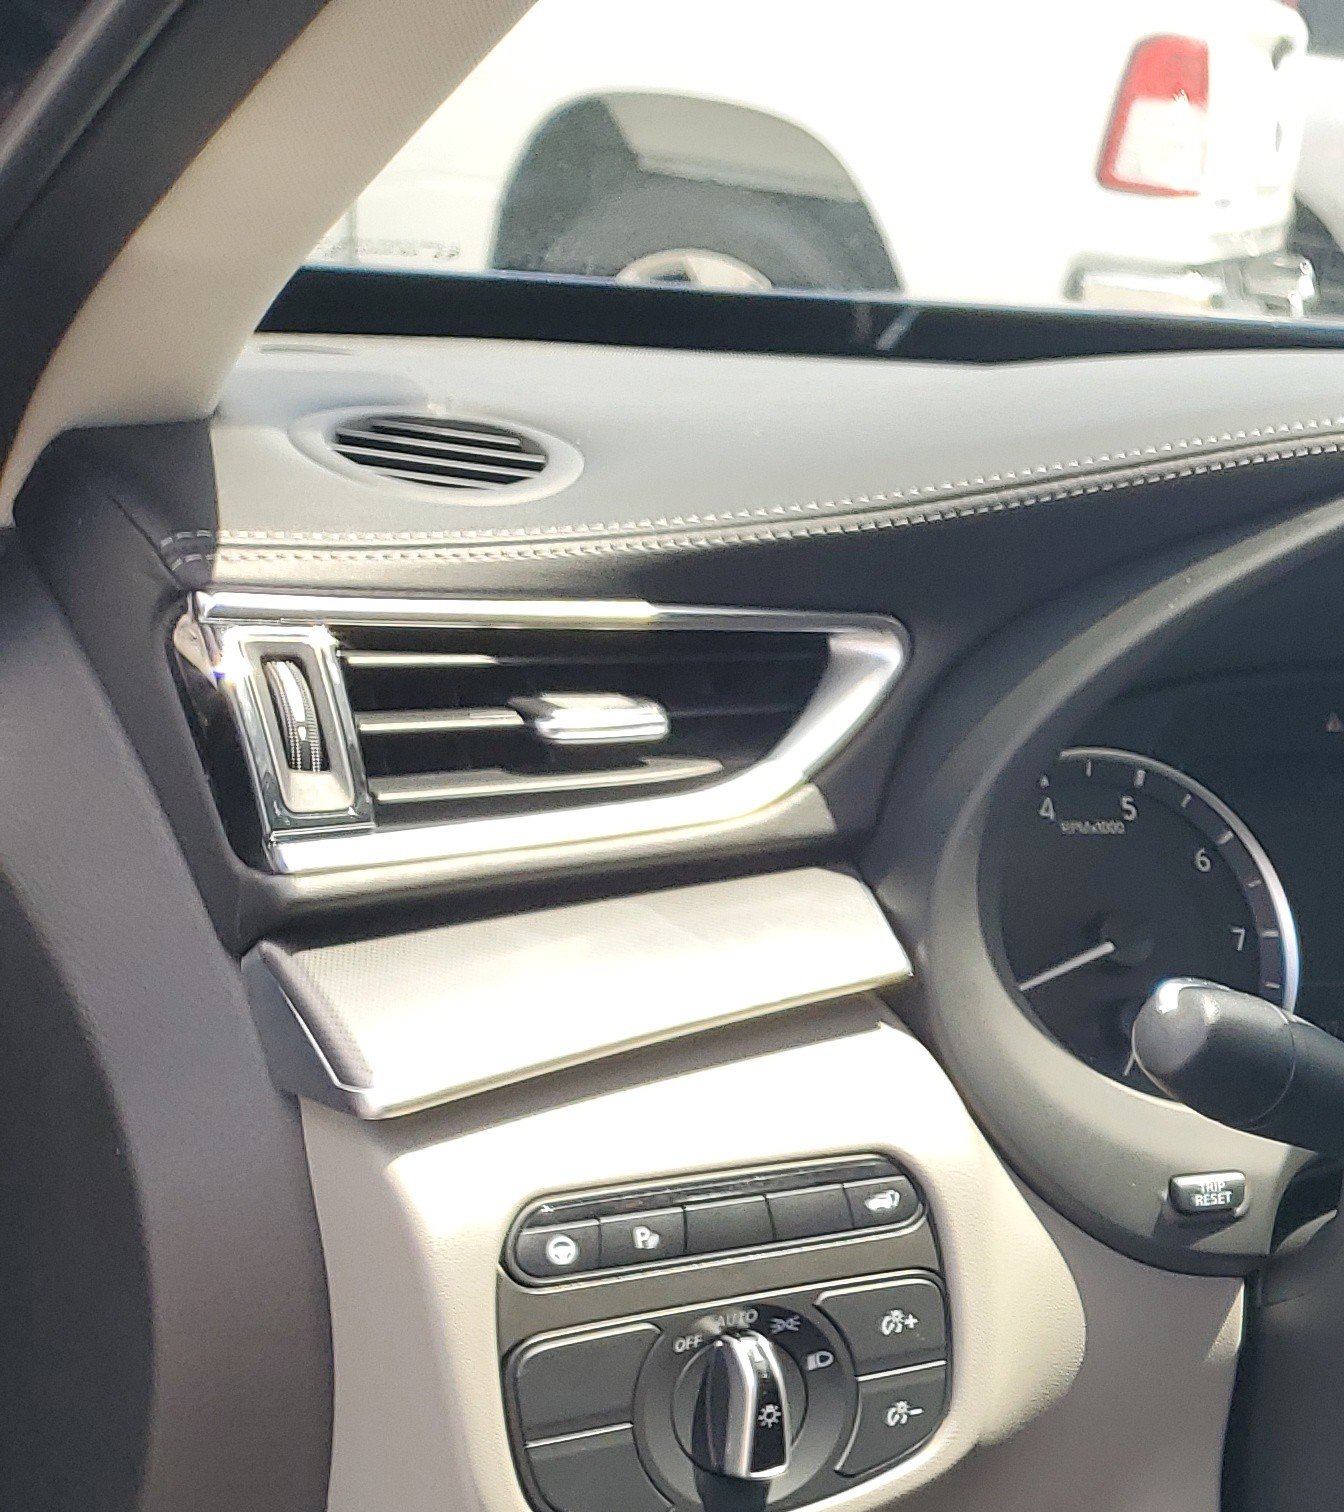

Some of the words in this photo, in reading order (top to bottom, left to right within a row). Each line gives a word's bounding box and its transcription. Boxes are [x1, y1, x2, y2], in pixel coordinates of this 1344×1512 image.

[1039, 797, 1055, 820] 4
[1121, 796, 1138, 821] 5
[1195, 849, 1211, 872] 6
[1230, 926, 1245, 950] 7
[1194, 1191, 1232, 1206] RESET
[674, 1337, 704, 1353] OFF
